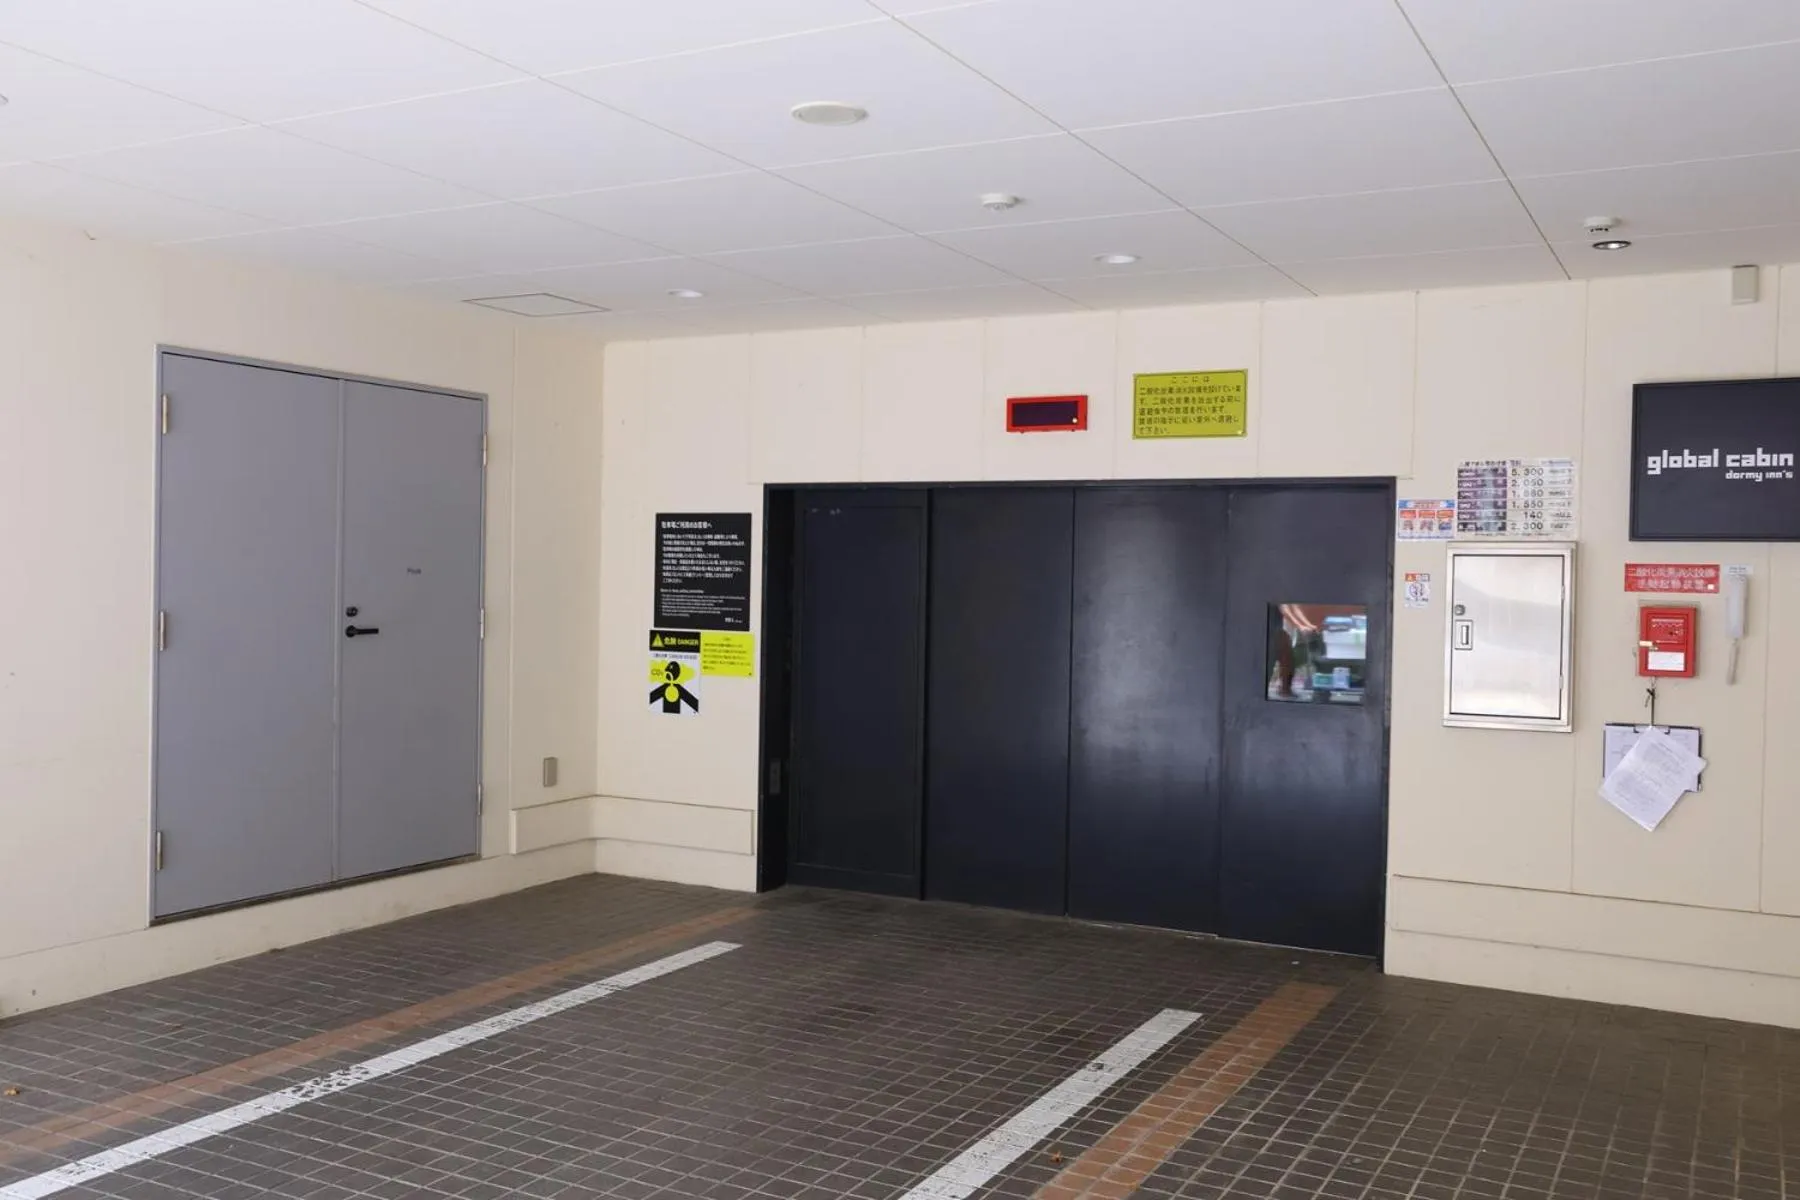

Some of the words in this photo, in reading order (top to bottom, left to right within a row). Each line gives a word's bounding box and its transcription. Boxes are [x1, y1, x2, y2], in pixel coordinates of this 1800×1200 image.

[1647, 448, 1719, 475] global
[1726, 447, 1794, 467] cabin
[1725, 469, 1763, 482] dormy
[1765, 470, 1794, 479] inn's
